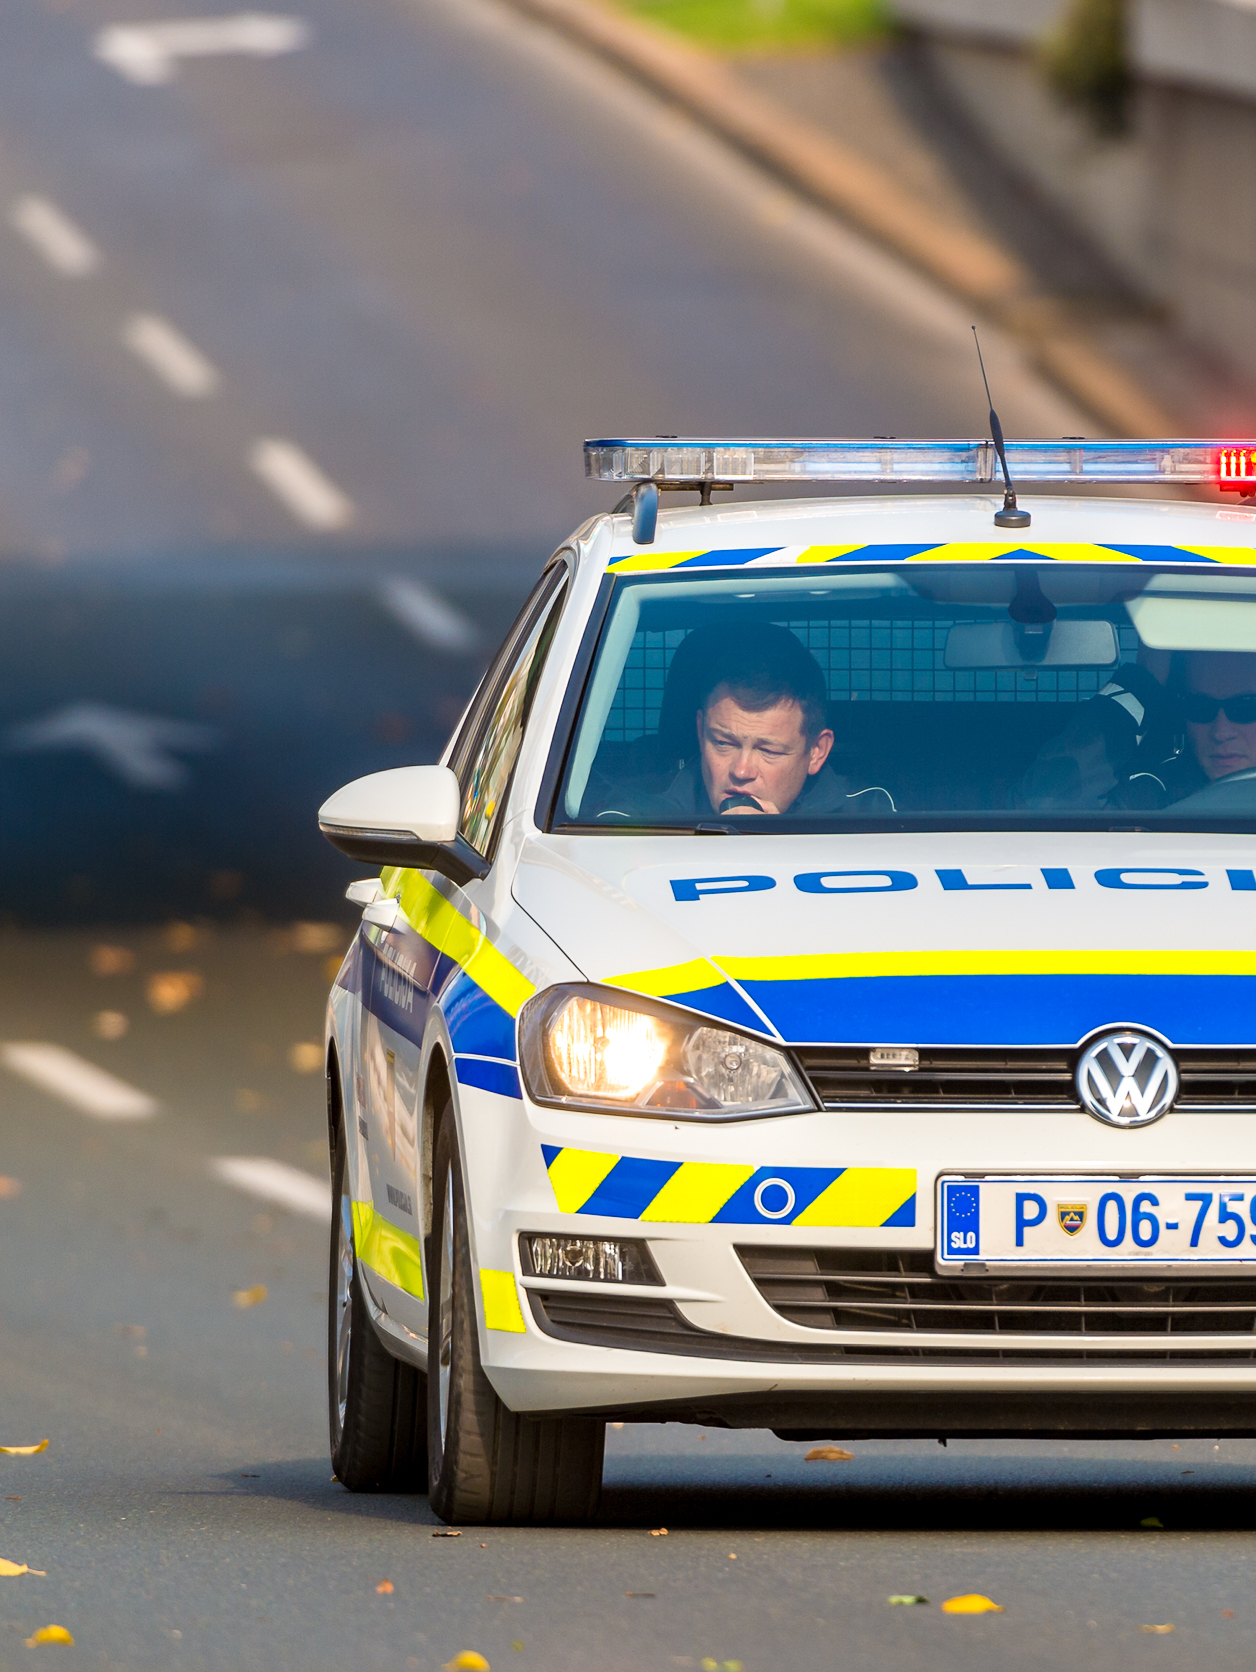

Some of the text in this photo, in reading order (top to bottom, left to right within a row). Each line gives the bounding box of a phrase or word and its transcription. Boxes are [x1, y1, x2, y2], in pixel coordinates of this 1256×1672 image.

[1080, 1036, 1175, 1122] VW
[951, 1231, 976, 1249] SLO
[1015, 1192, 1048, 1247] P
